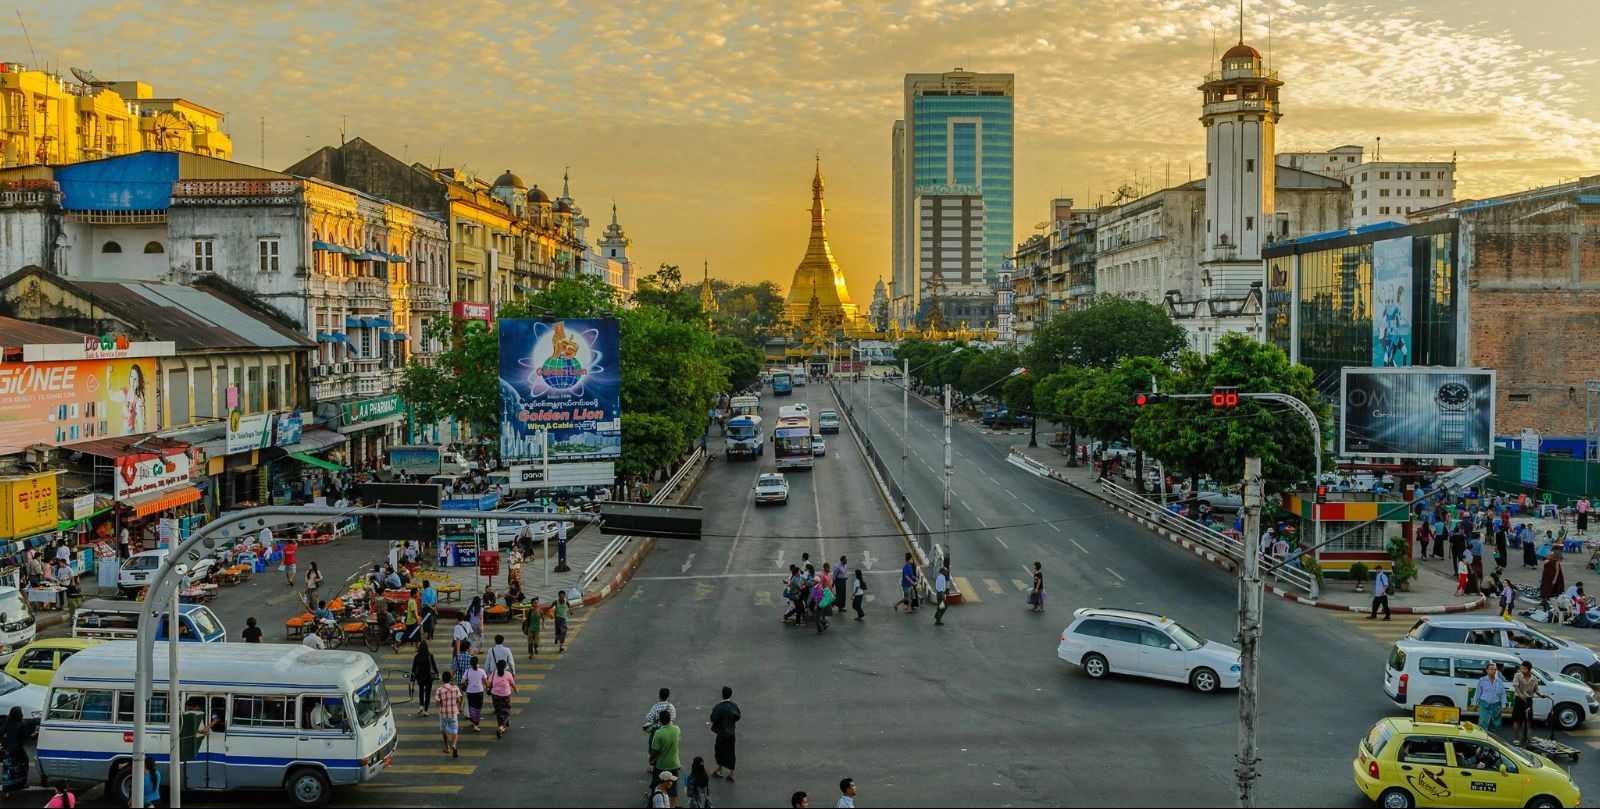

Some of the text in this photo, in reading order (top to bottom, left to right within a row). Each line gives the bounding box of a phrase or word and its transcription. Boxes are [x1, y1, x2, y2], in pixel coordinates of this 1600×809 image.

[536, 366, 588, 377] Golden Lion
[369, 399, 398, 415] PHARMACY
[518, 408, 605, 422] Golden Lion
